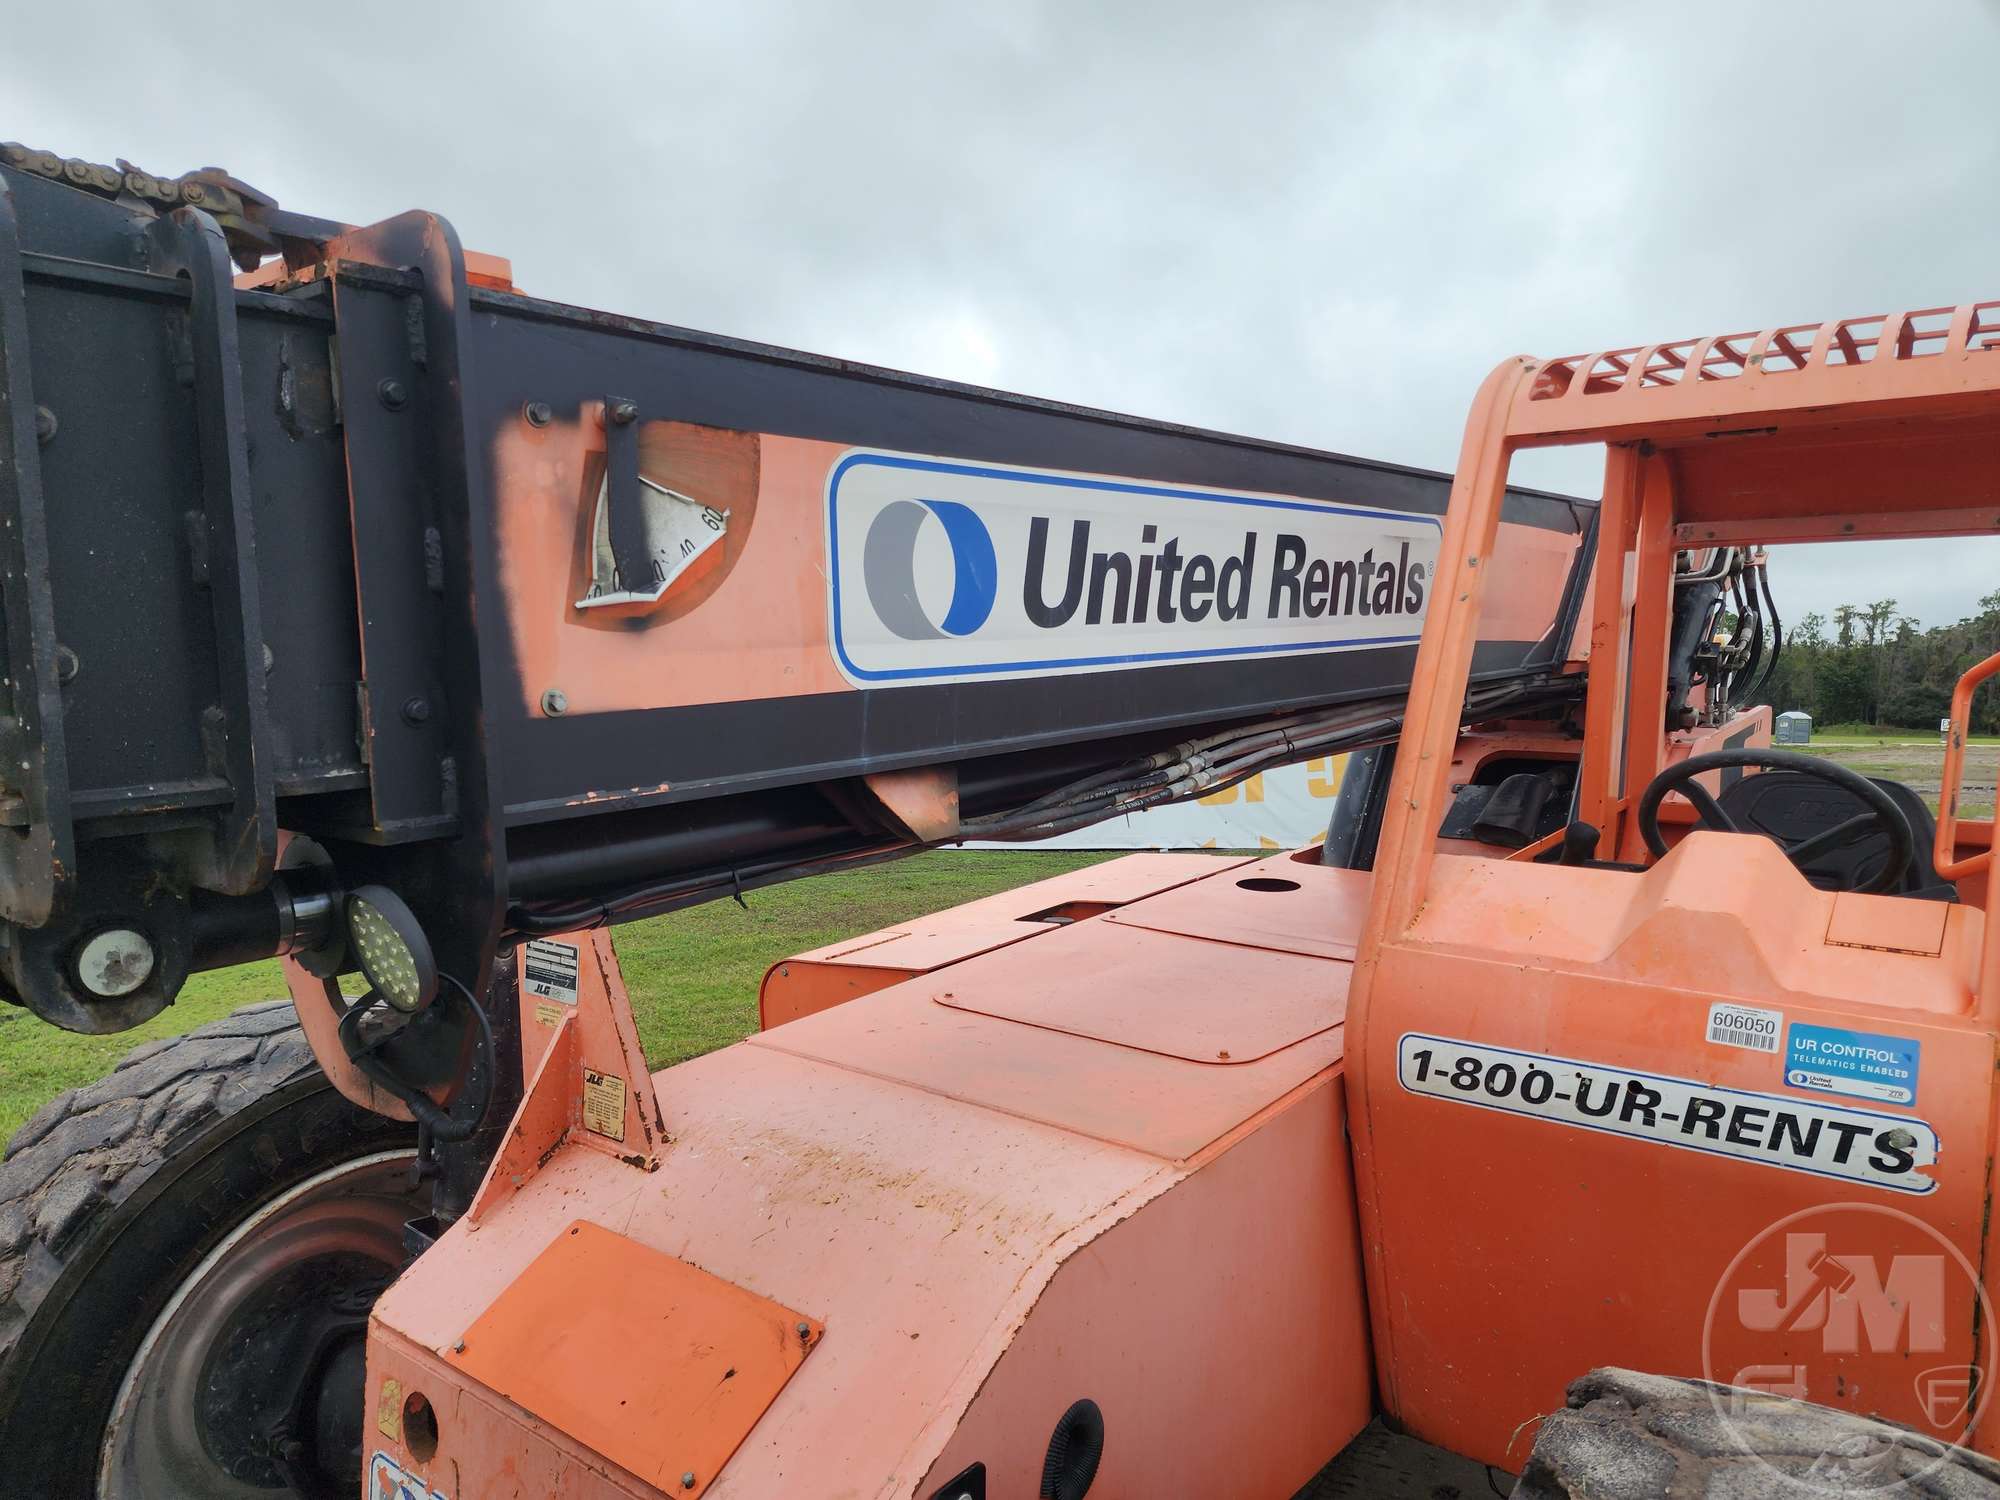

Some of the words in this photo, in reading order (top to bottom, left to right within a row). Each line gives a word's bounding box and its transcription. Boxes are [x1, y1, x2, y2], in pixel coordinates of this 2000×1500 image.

[1024, 516, 1257, 628] United
[1268, 534, 1426, 619] Rentals
[534, 983, 551, 996] JLG
[1713, 1011, 1776, 1035] 606050
[1795, 1037, 1817, 1052] UR
[1821, 1041, 1899, 1064] CONTROL
[1794, 1053, 1856, 1071] TELEMATICS
[1860, 1063, 1909, 1079] ENABLED
[586, 1073, 604, 1087] JLG
[1808, 1080, 1833, 1089] Rentals
[1809, 1074, 1832, 1084] United
[1411, 1048, 1919, 1175] 1-800-UR-RENTS
